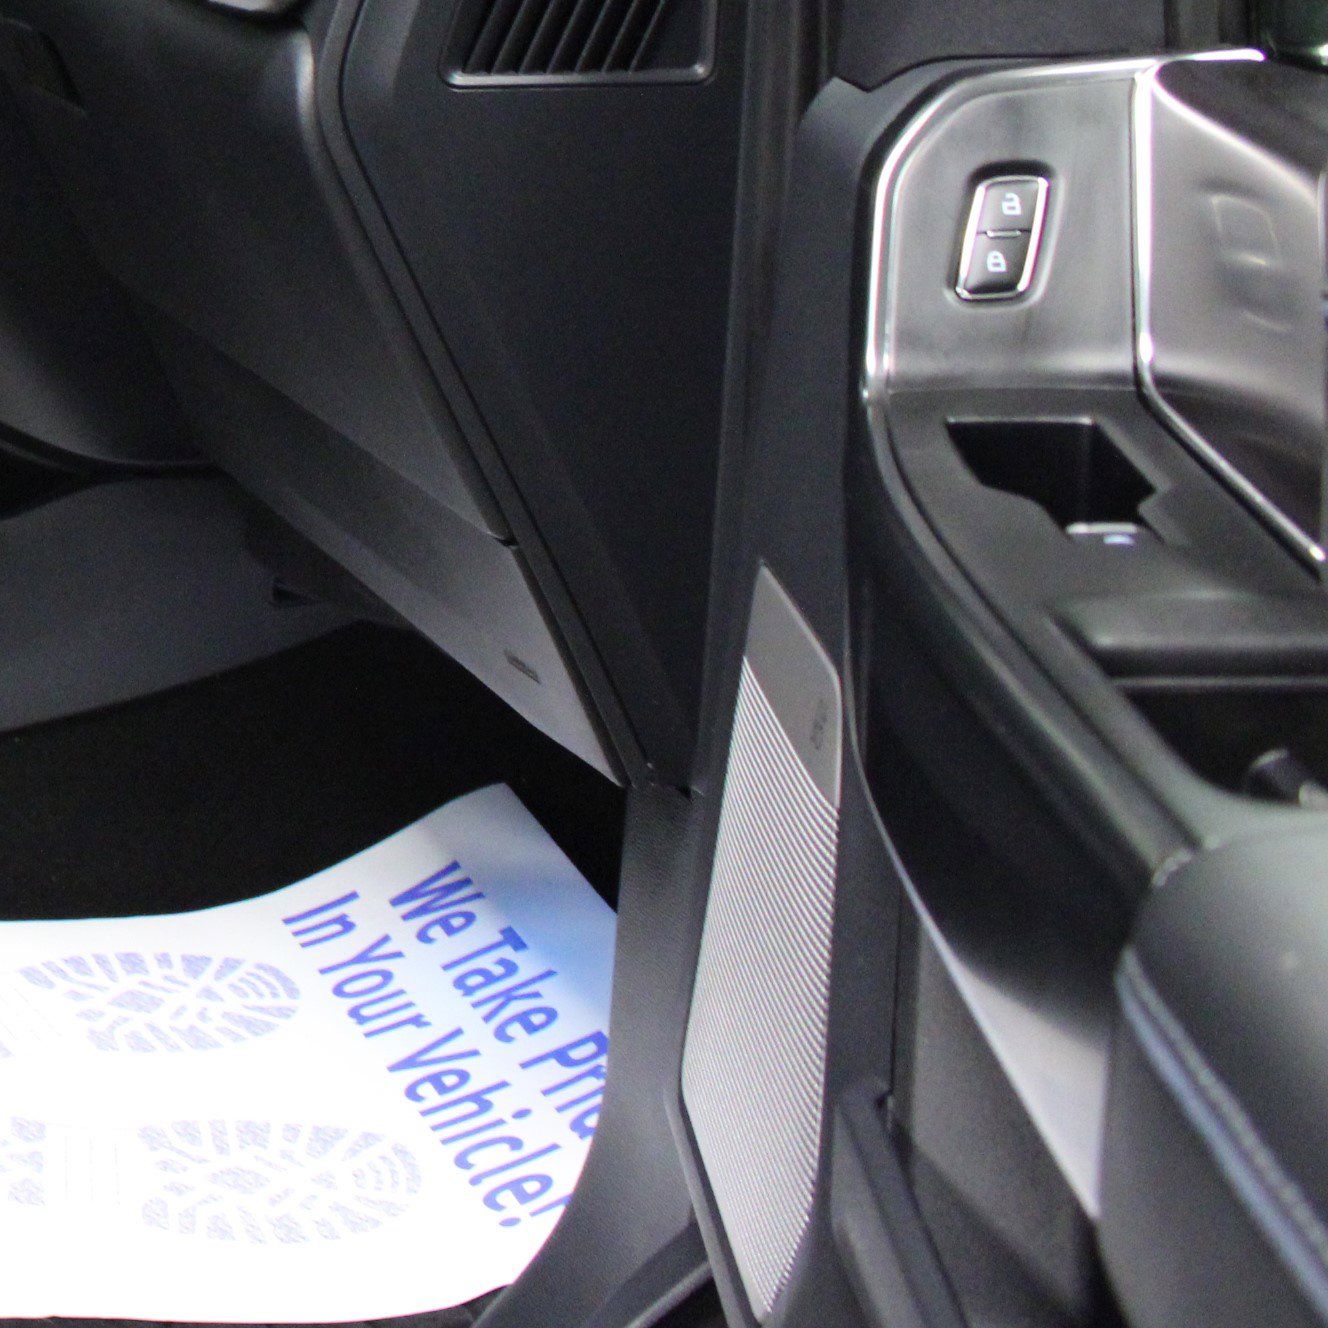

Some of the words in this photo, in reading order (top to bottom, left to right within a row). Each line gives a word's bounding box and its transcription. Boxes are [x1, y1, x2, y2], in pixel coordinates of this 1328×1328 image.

[281, 890, 360, 949] In
[318, 934, 432, 1039] Your
[389, 860, 486, 945] We
[440, 926, 559, 1044] Take
[386, 1026, 573, 1228] Vehicle!
